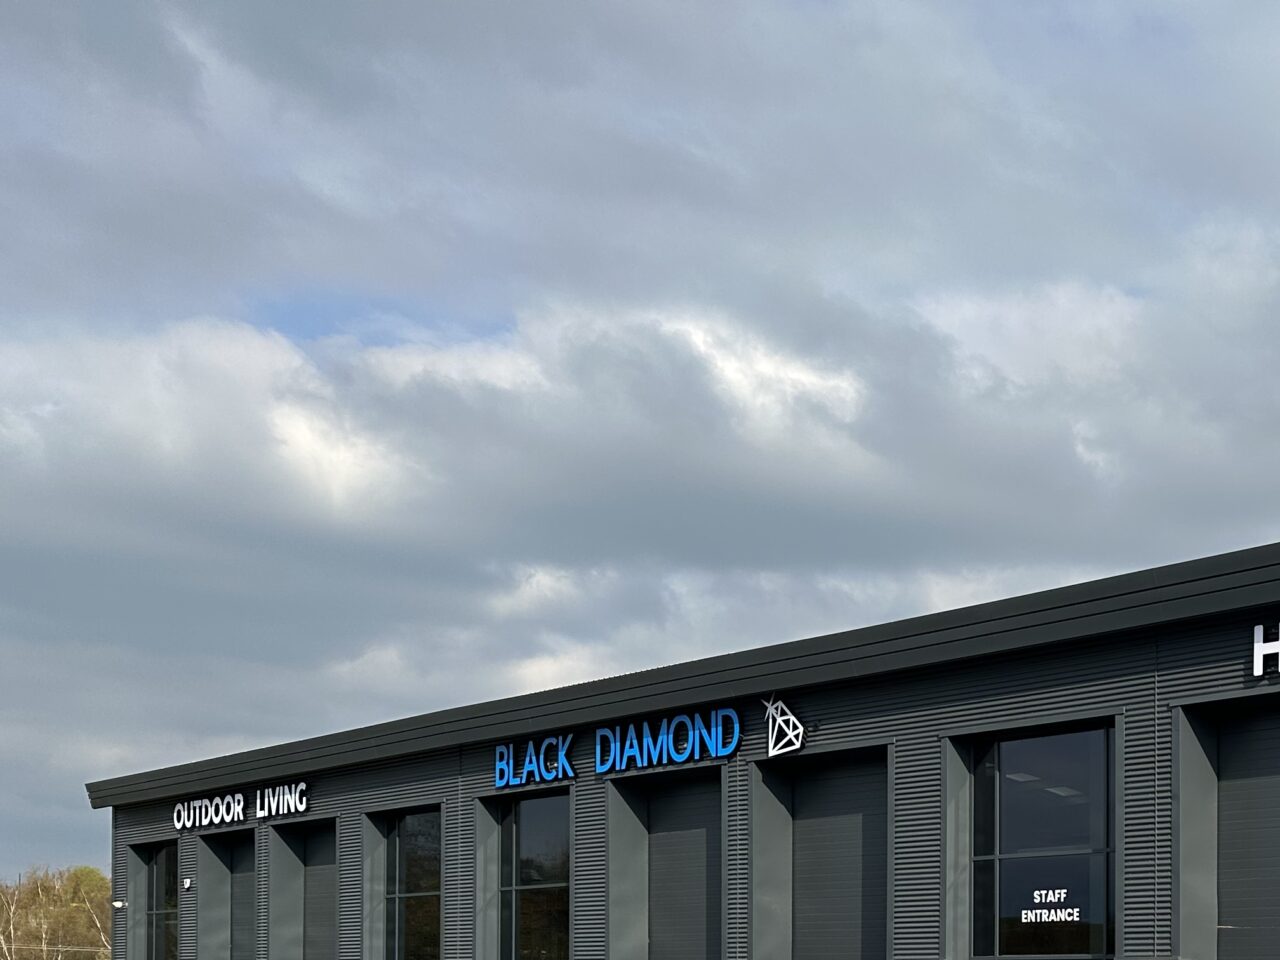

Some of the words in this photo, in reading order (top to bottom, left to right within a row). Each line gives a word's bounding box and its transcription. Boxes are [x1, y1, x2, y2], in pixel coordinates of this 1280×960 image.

[495, 733, 575, 788] BLACK
[595, 708, 740, 774] DIAMOND
[173, 793, 244, 830] OUTDOOR
[256, 782, 307, 818] LIVING
[1033, 889, 1068, 903] STAFF
[1021, 908, 1080, 923] ENTRANCE
